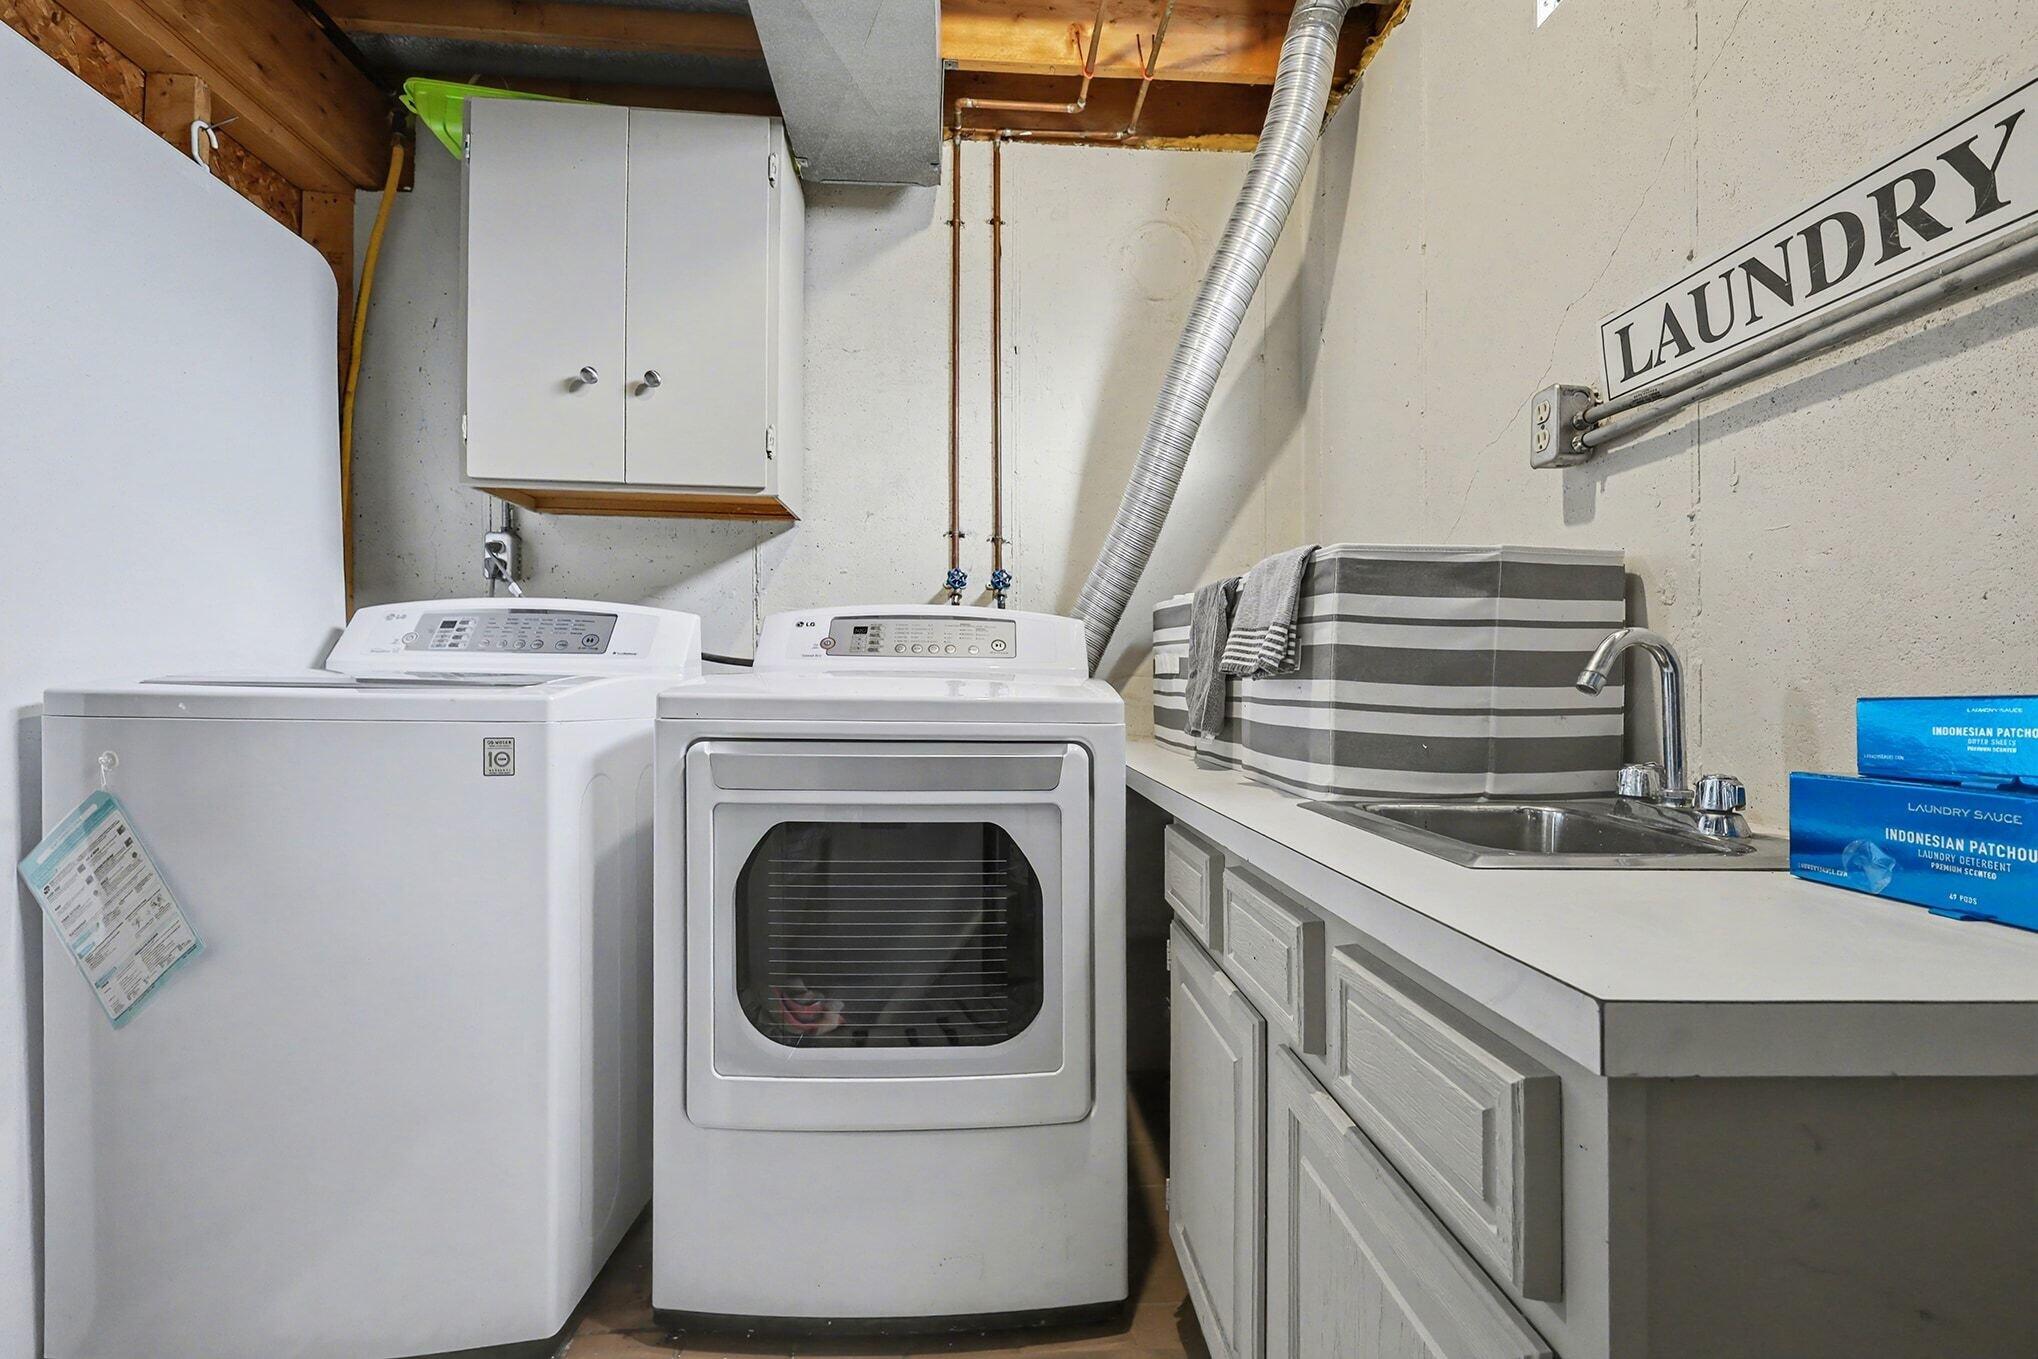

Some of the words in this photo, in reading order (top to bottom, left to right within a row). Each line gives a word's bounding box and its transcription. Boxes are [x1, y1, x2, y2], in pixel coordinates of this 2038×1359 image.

[1615, 108, 2025, 383] LAUNDRY
[1932, 726, 1993, 737] INDONESIAN
[1908, 802, 1971, 817] LAUNDRY
[1974, 810, 2023, 825] SAUCE
[1885, 827, 1965, 851] INDONESIAN
[1969, 840, 2038, 864] PATCHOU
[1918, 849, 1956, 863] LAUNDRY
[1959, 855, 2012, 873] DETERGENT
[1931, 862, 1962, 874] PREMIUM
[1964, 868, 1997, 880] SCENTED
[1959, 895, 1978, 905] PODS
